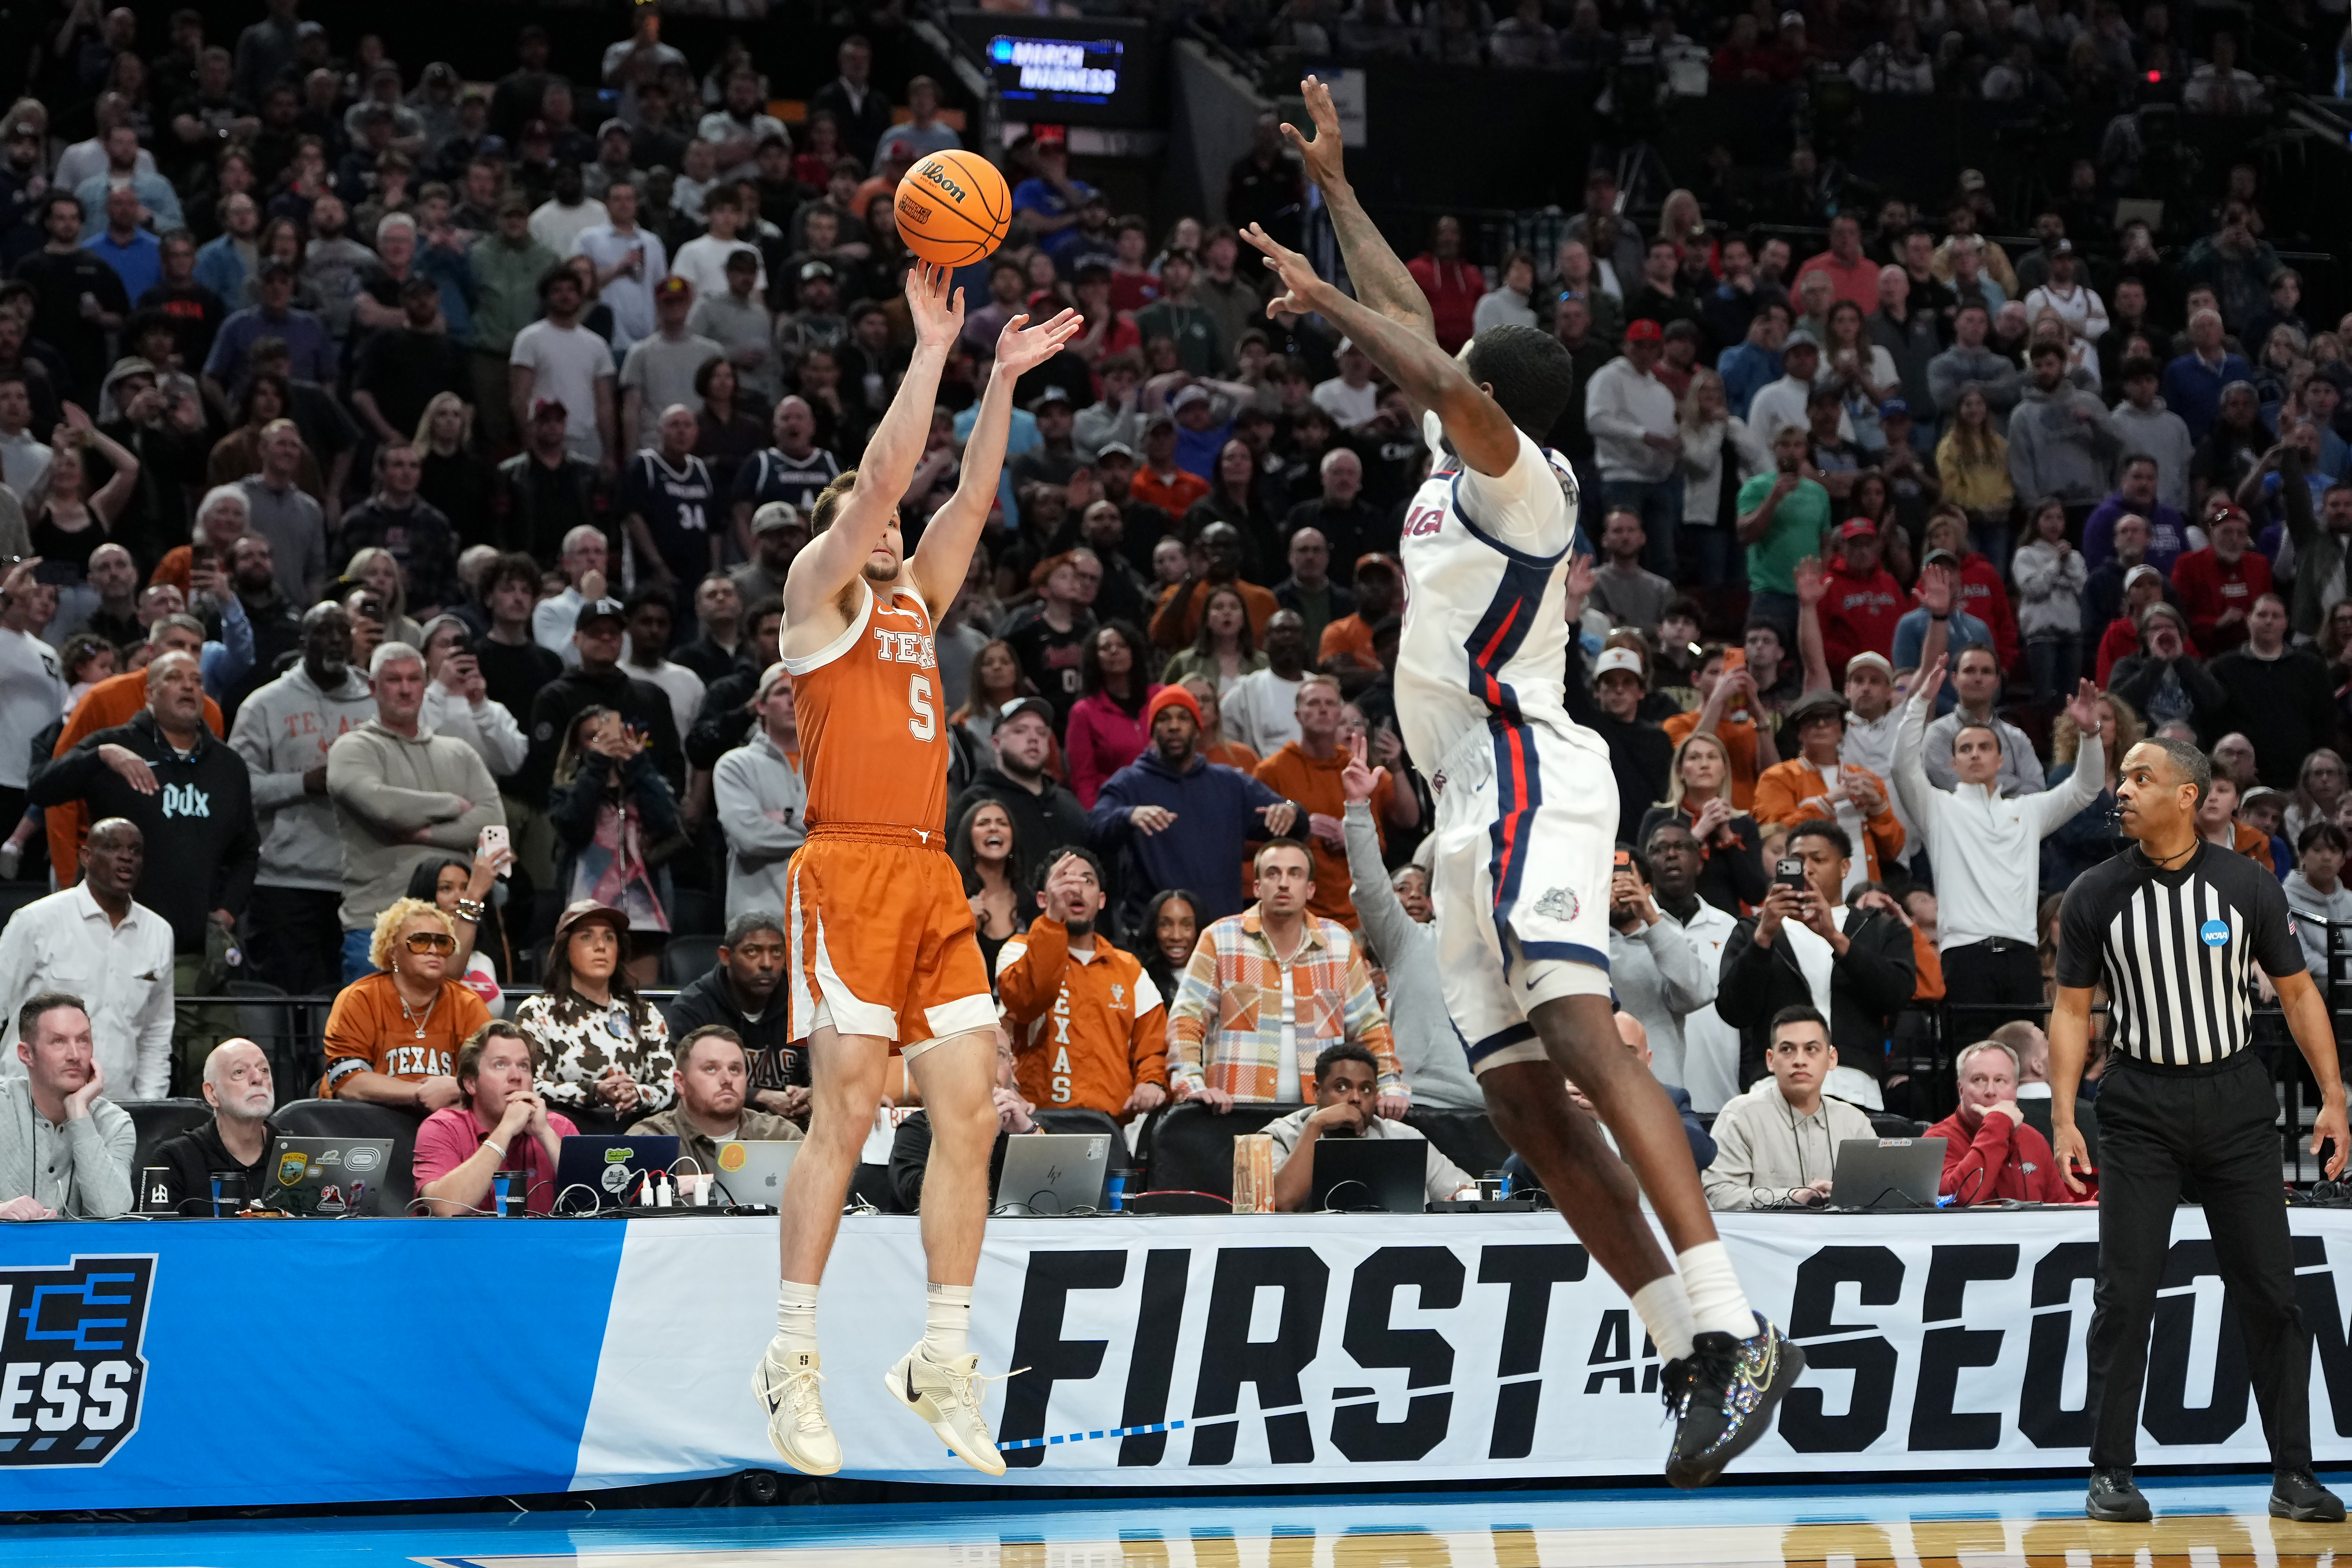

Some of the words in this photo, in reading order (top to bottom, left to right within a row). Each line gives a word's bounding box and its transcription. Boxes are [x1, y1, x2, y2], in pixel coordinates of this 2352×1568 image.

[1019, 68, 1116, 94] MADNESS
[909, 673, 936, 743] 5
[2205, 931, 2228, 941] NCAA
[386, 1047, 452, 1077] TEXAS
[999, 1244, 1589, 1467] FIRST
